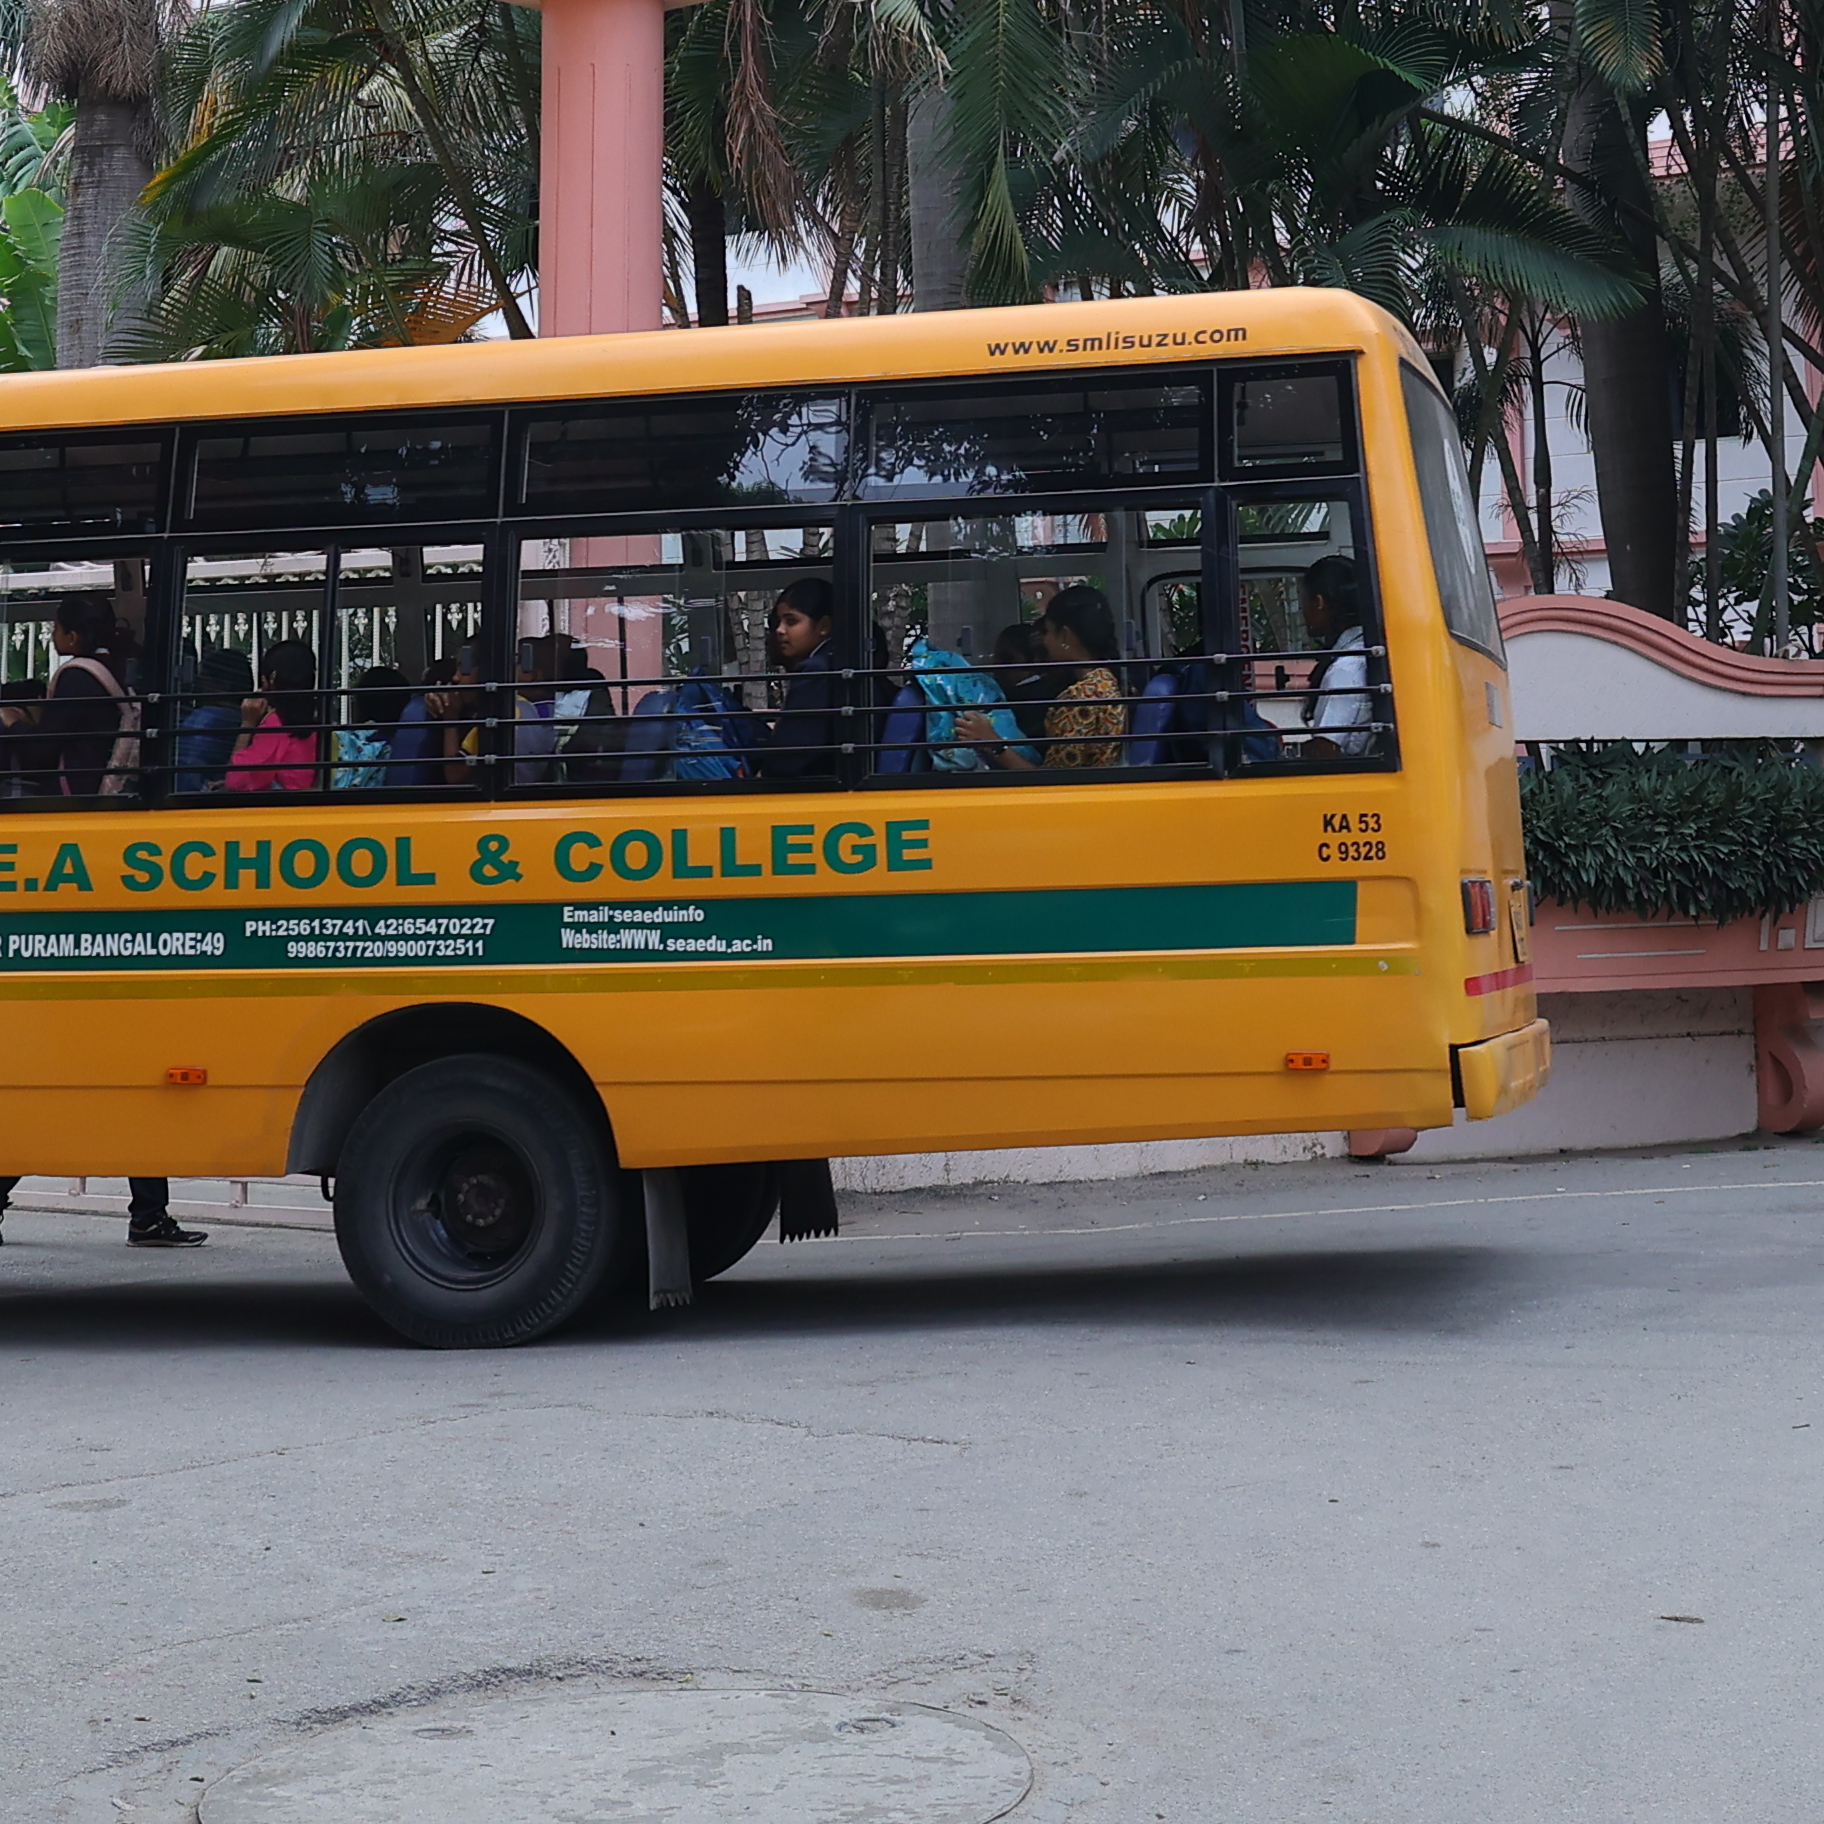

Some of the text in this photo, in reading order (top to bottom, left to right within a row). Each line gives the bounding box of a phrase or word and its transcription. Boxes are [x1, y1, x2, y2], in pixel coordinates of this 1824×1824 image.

[987, 327, 1247, 357] www.smlisuzu.com
[1323, 812, 1382, 833] KA 53
[120, 835, 436, 893] SCHOOL
[469, 833, 524, 886] &
[554, 819, 933, 883] COLLEGE
[1318, 841, 1386, 862] C 9328
[287, 938, 484, 959] 9986737720/9900732511
